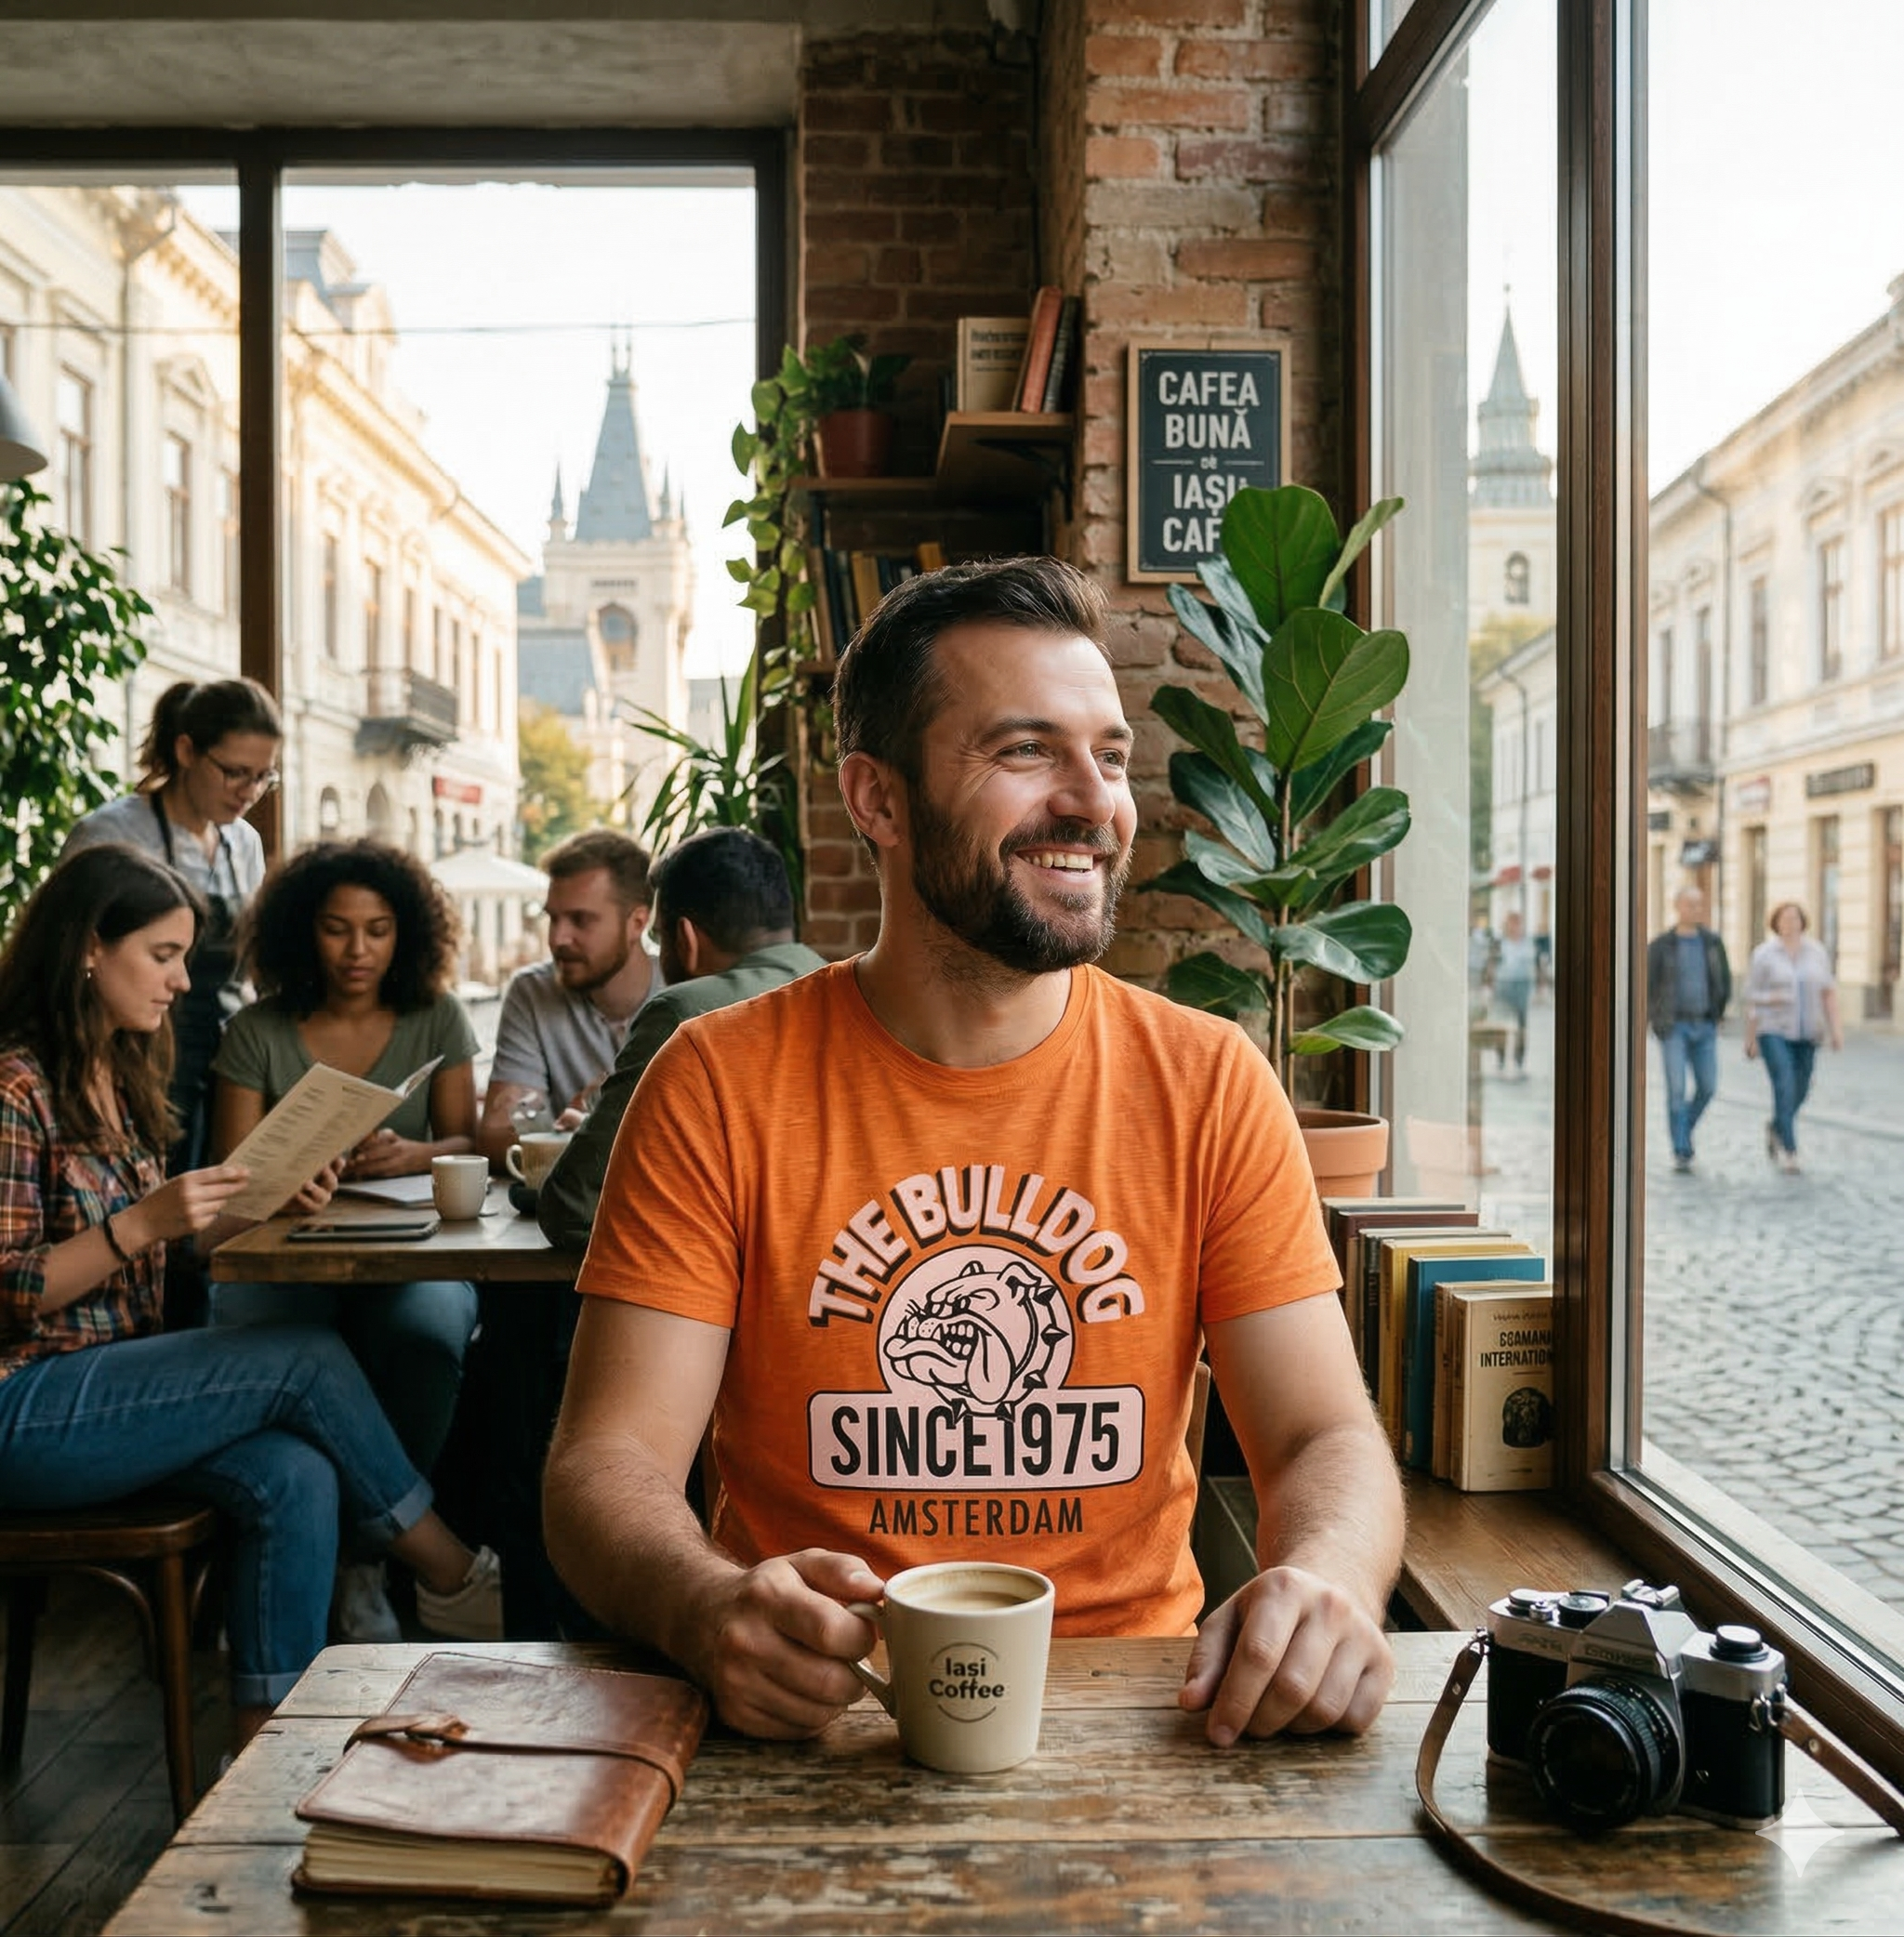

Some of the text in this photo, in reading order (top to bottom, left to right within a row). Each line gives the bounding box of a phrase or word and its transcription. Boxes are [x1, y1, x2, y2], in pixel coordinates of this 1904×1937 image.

[1158, 371, 1260, 406] CAFEA
[1165, 408, 1251, 449] BUNĂ
[809, 1165, 1145, 1327] THE BULLDOG
[831, 1402, 1120, 1477] SINCE 1975
[868, 1497, 1083, 1536] AMSTERDAM
[929, 1678, 1005, 1700] Coffee
